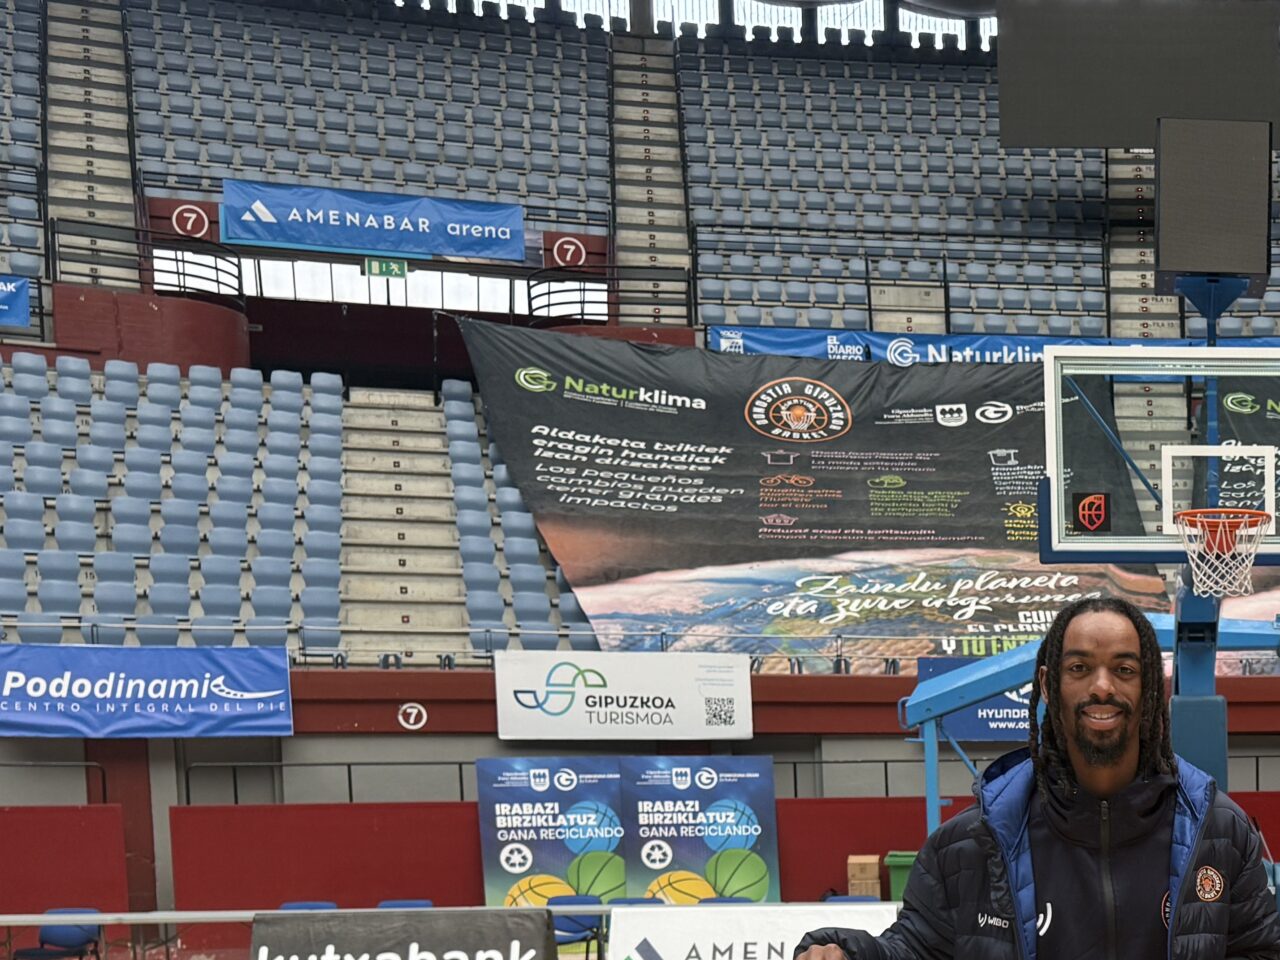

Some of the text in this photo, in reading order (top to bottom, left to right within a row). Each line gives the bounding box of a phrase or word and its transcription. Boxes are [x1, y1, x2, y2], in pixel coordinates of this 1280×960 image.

[182, 212, 198, 231] 7
[287, 207, 511, 241] AMENABAR arena
[562, 244, 577, 262] 7
[827, 335, 841, 345] EL
[827, 345, 864, 356] DIARIO
[926, 343, 1044, 363] Naturkli
[563, 375, 707, 411] Naturklima
[530, 424, 735, 458] Aldaketa txikiek
[532, 438, 728, 465] eragin handiak
[533, 447, 713, 472] izan ditzakete
[535, 462, 706, 486] Los pequeños
[536, 474, 644, 491] cambios
[649, 484, 746, 496] pueden
[546, 484, 724, 504] tener grandes
[558, 493, 679, 513] impactos
[950, 570, 1080, 599] planeta
[765, 595, 819, 618] eta
[818, 593, 917, 625] zure
[966, 623, 992, 633] EL
[941, 636, 957, 655] Y
[960, 635, 986, 656] TU
[0, 701, 288, 714] CENTRO INTEGRAL DEL PIE
[584, 694, 676, 711] GIPUZKOA
[405, 708, 420, 725] 7
[584, 710, 675, 726] TURISMOA
[977, 708, 1030, 719] HYUNDA
[494, 801, 560, 816] IRABAZI
[637, 800, 700, 814] IRABAZI
[495, 813, 598, 829] BIRZIKLATUZ
[637, 811, 736, 826] BIRZIKLATUZ
[496, 826, 626, 842] GANA RECICLANDO
[638, 823, 763, 839] GANA RECICLANDO
[987, 916, 1010, 929] WIBO
